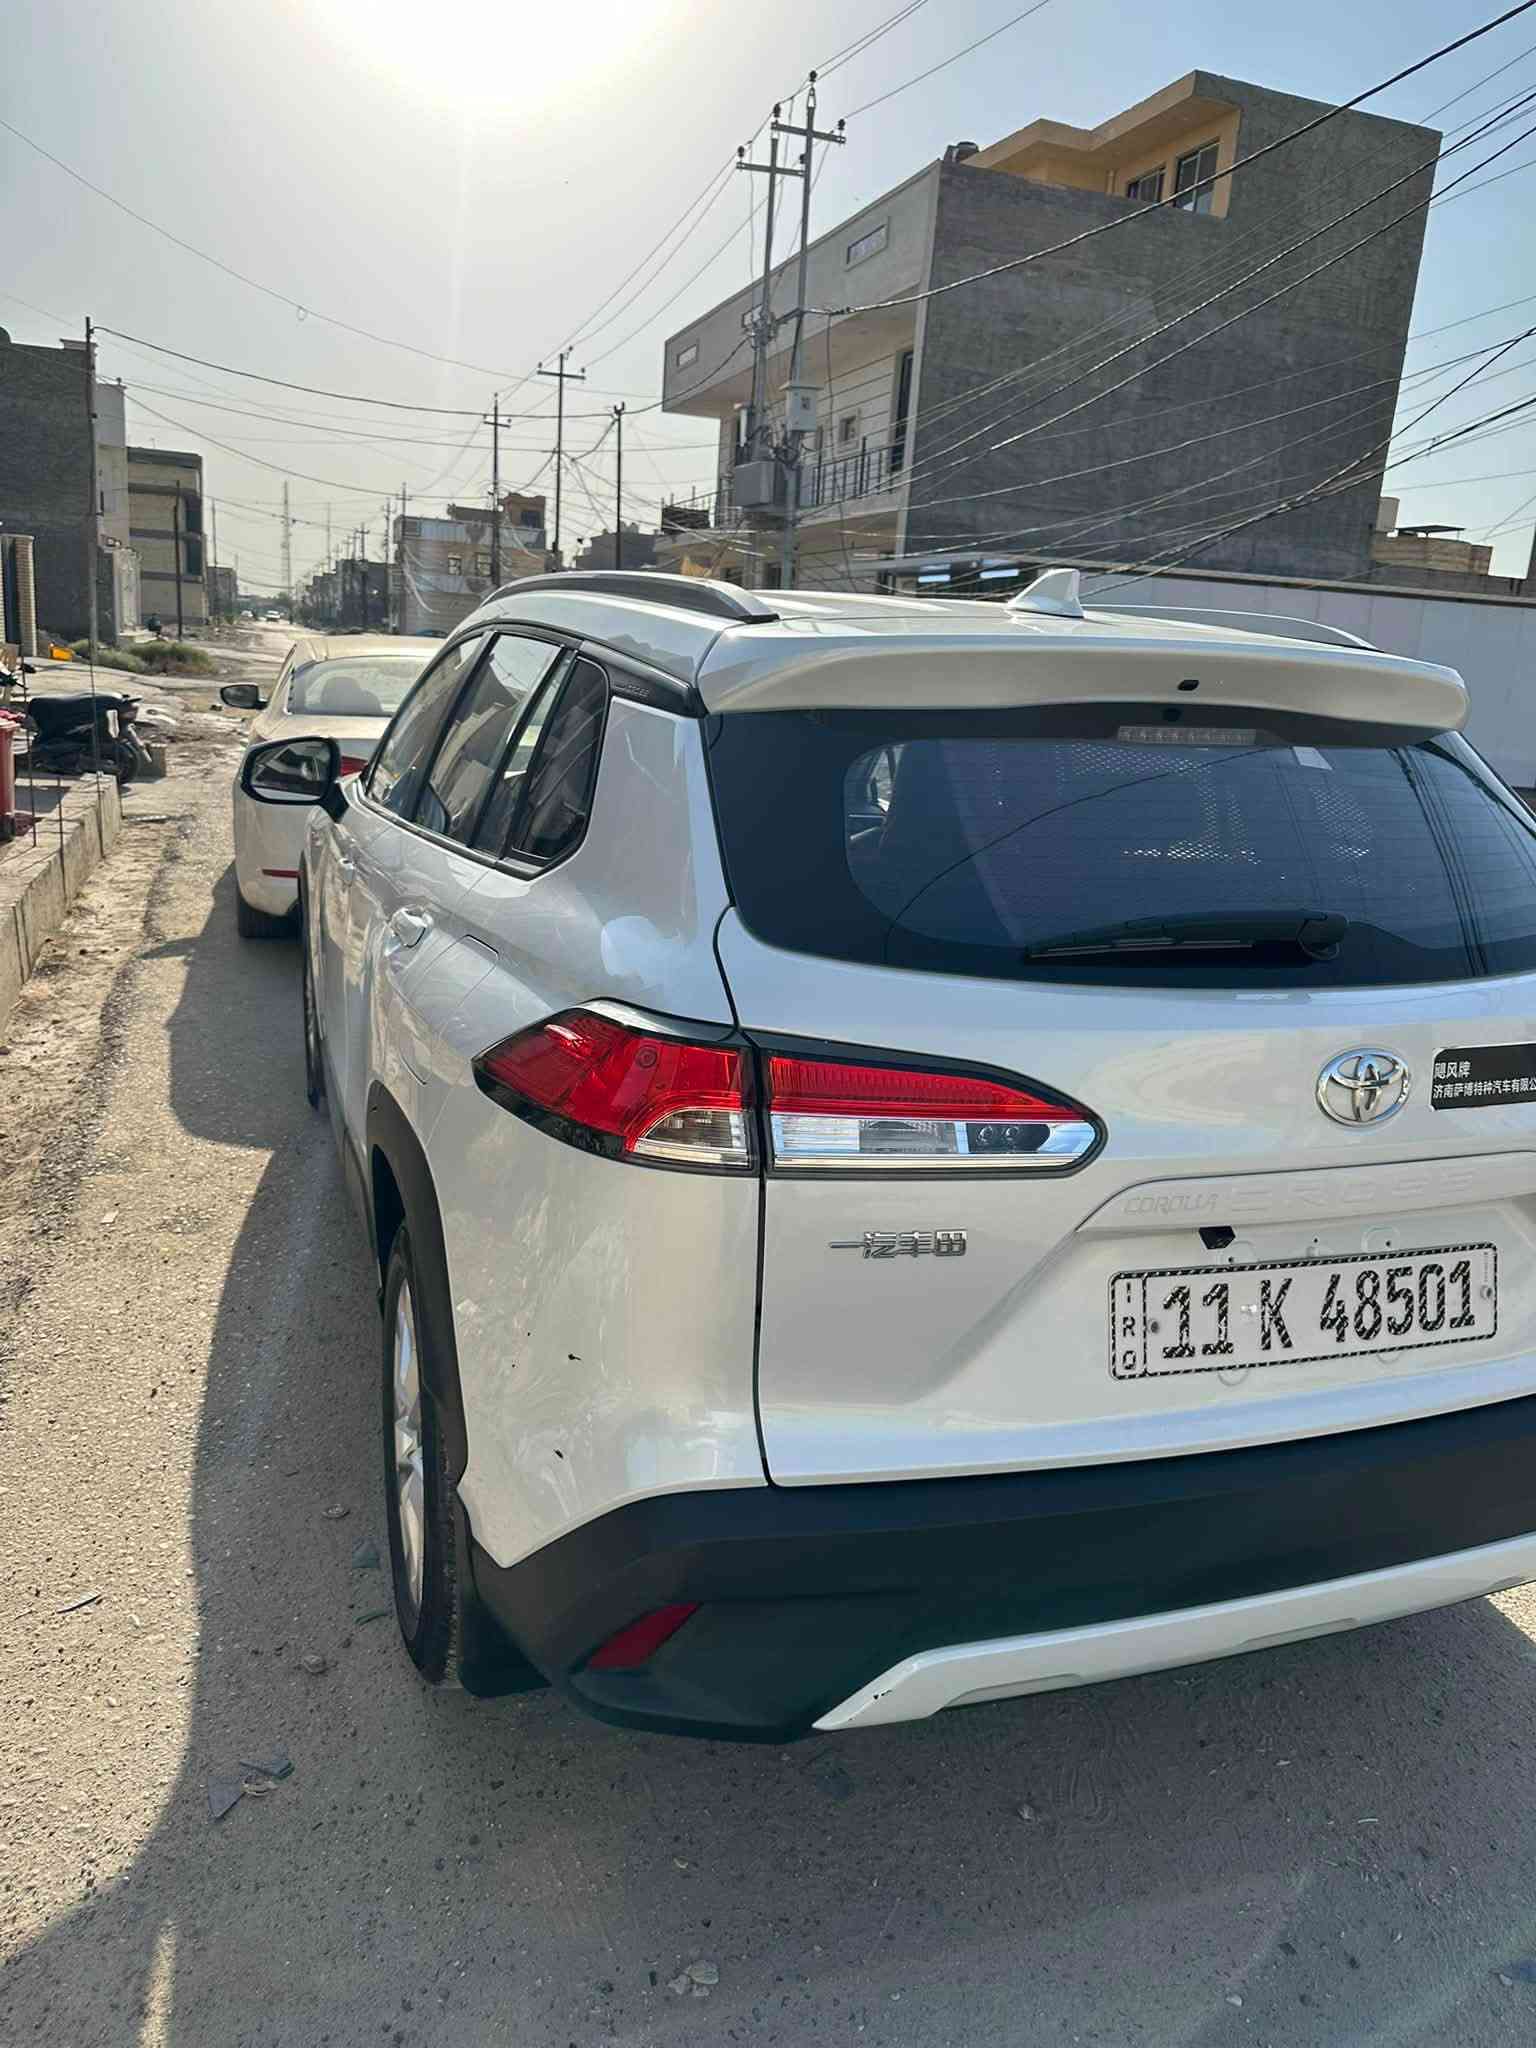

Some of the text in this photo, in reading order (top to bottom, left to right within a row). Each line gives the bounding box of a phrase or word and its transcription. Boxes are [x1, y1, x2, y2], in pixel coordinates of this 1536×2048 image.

[829, 1229, 967, 1259] 一汽丰田
[1122, 1282, 1136, 1370] IRQ
[1163, 1283, 1233, 1359] 11
[1261, 1278, 1293, 1350] K
[1320, 1260, 1475, 1343] 48501
